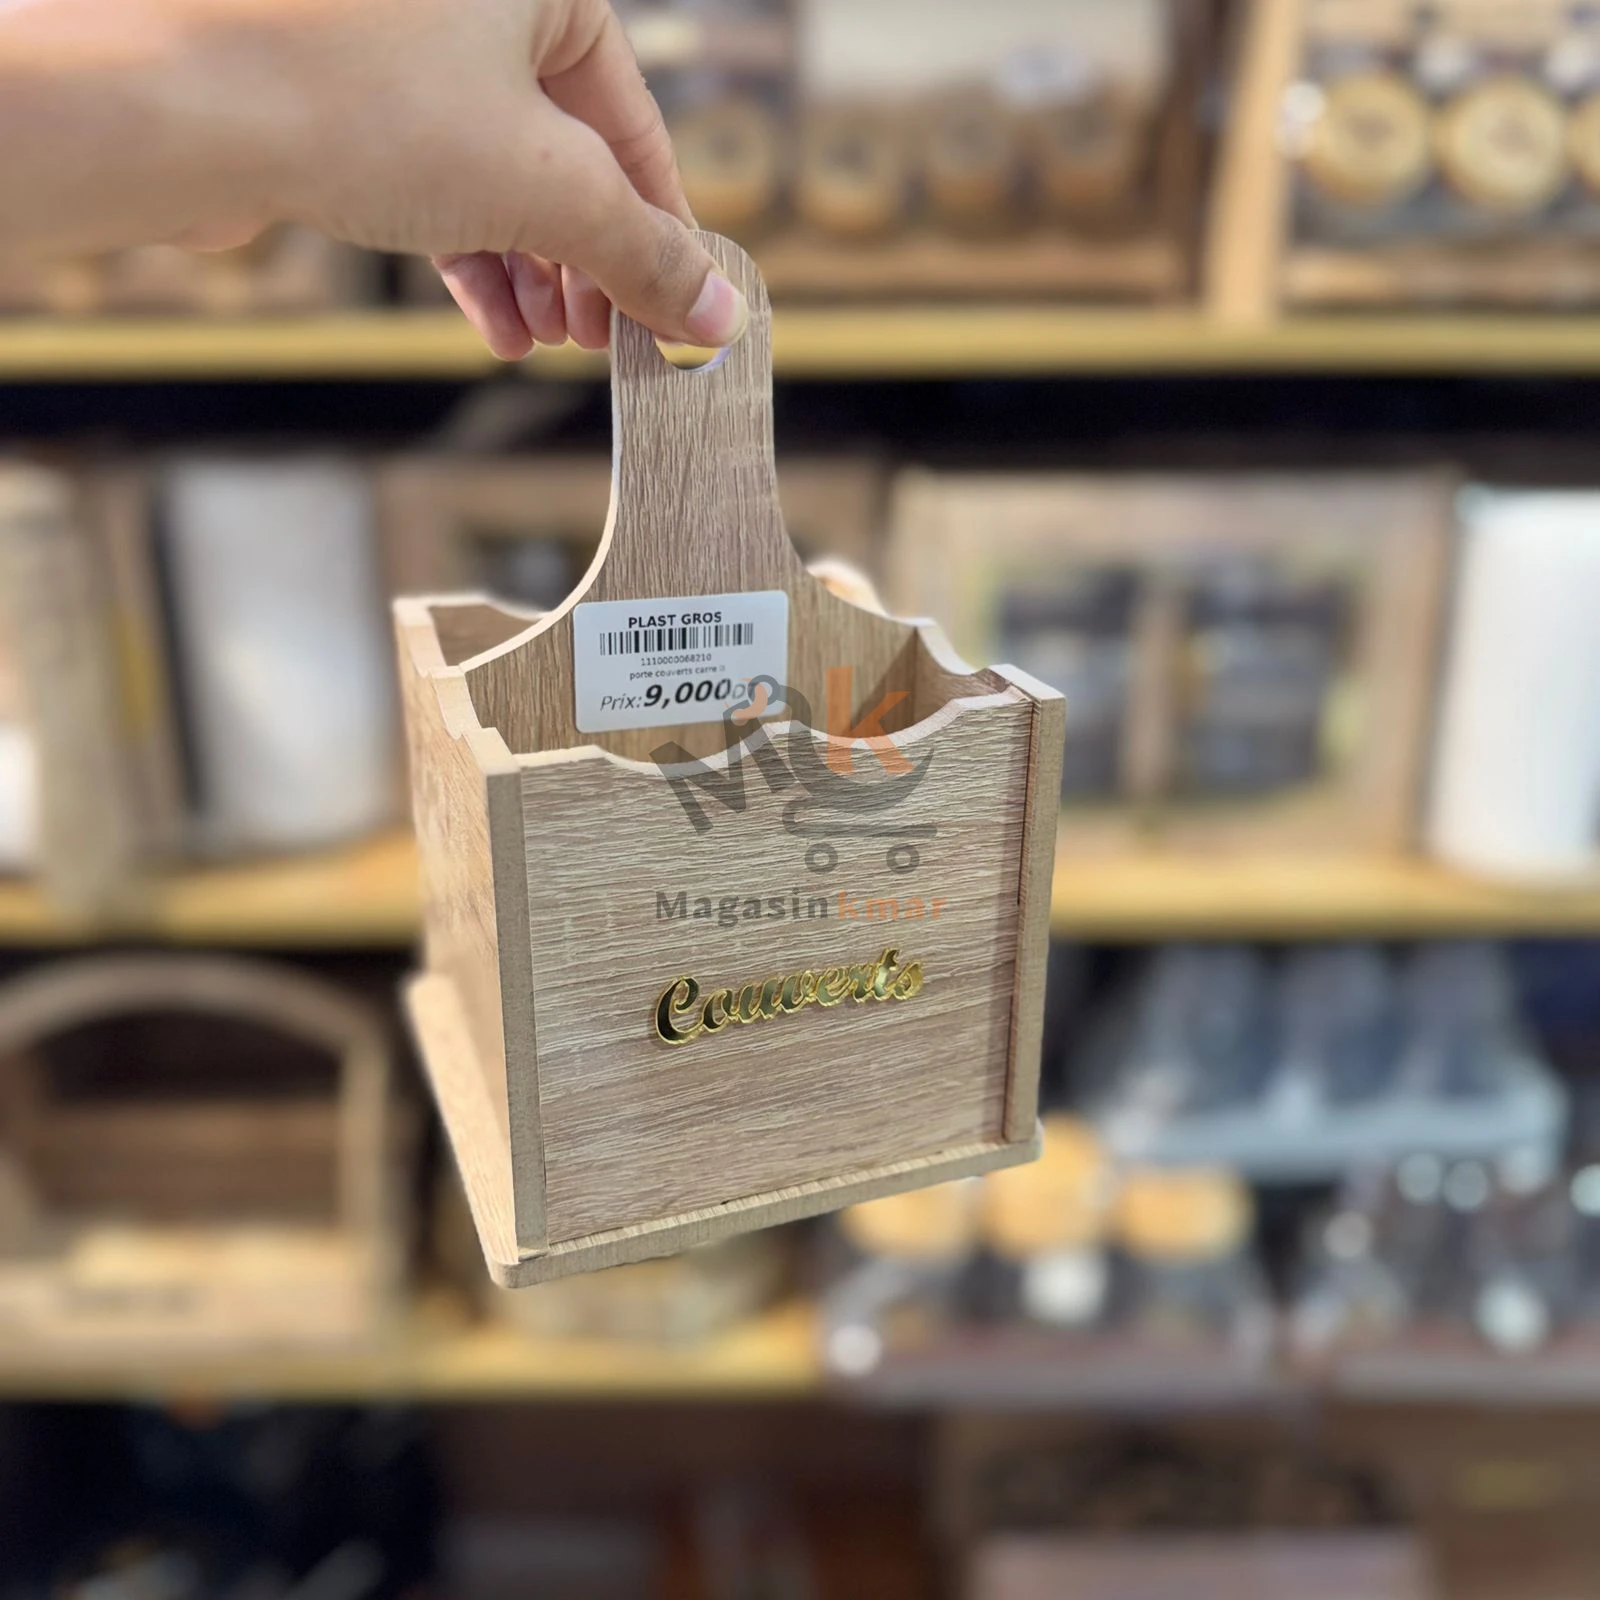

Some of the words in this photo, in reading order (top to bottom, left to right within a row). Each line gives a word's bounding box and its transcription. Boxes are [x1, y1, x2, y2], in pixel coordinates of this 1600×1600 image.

[628, 614, 676, 629] PLAST
[681, 611, 722, 625] GROS
[630, 671, 653, 680] porte
[655, 667, 693, 677] couverts
[655, 947, 925, 1045] Couverts
